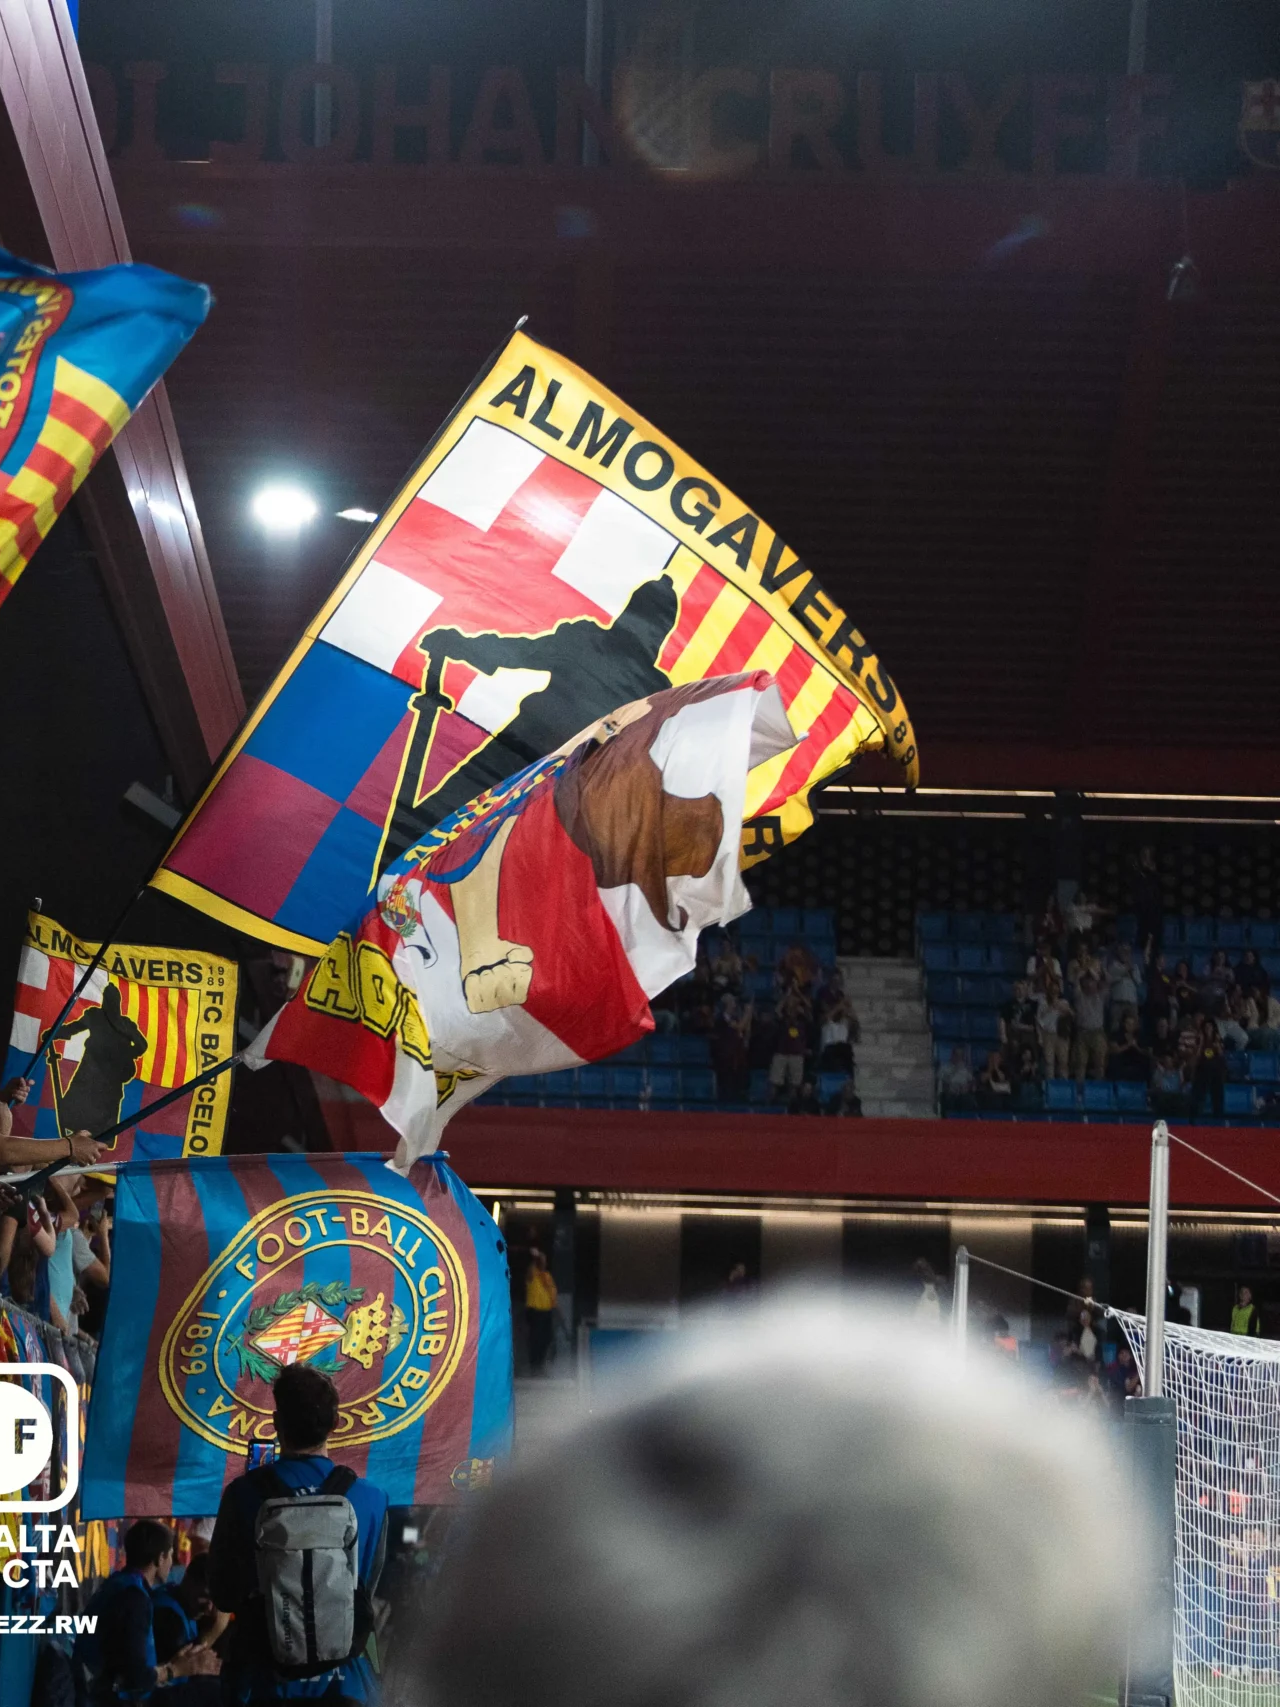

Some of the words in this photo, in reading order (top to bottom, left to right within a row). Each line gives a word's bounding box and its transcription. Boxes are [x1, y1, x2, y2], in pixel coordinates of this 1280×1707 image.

[209, 61, 623, 167] JOHAN
[690, 66, 1175, 177] CRUYFF
[488, 364, 897, 714] ALMOGAVERS
[204, 991, 223, 1023] FC
[187, 1033, 220, 1158] BACELO
[235, 1207, 424, 1281] FOOT-BALL
[180, 1310, 221, 1376] 1899
[416, 1266, 449, 1356] CLUB
[207, 1366, 431, 1441] BARCONA
